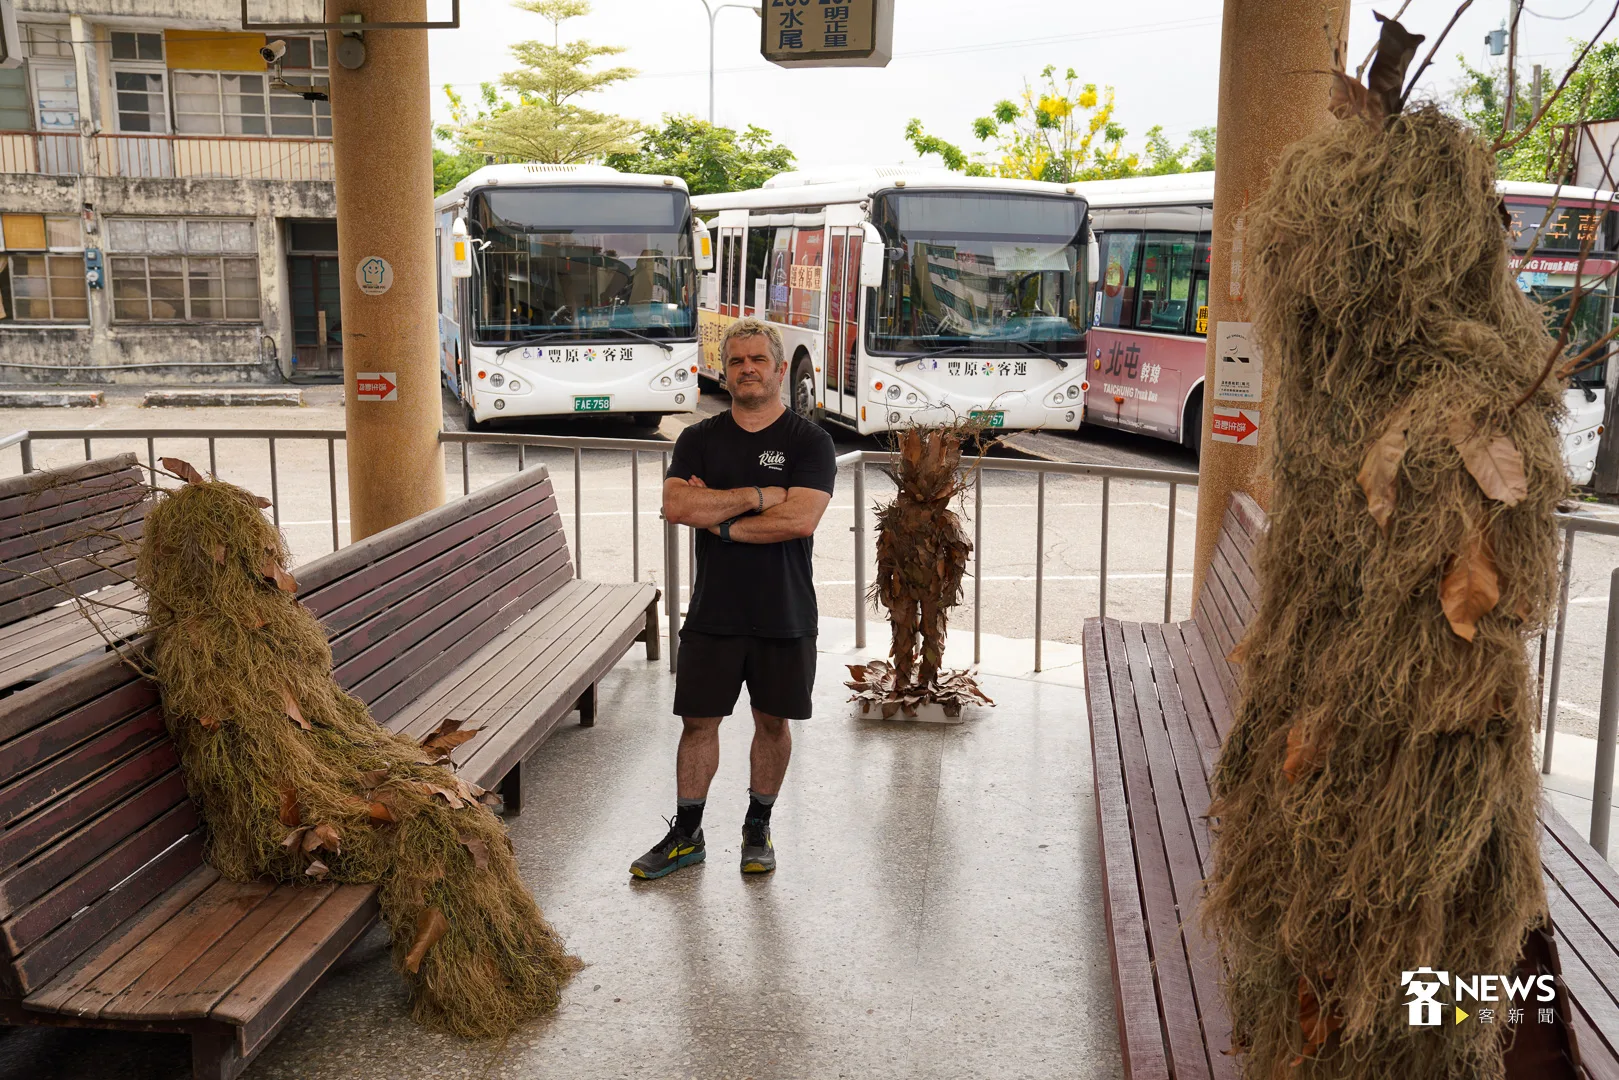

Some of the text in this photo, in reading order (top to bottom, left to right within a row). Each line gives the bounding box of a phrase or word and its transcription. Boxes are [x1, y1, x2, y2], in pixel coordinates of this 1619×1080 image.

[779, 8, 804, 49] 水尾
[824, 7, 848, 47] 明正里
[1540, 260, 1564, 271] Trunk
[548, 347, 634, 363] 豐原 客運
[1104, 340, 1161, 384] 北屯 幹線
[948, 361, 1028, 377] 豐原 客運
[1103, 382, 1135, 398] TAICHUNG
[758, 453, 785, 466] Ride
